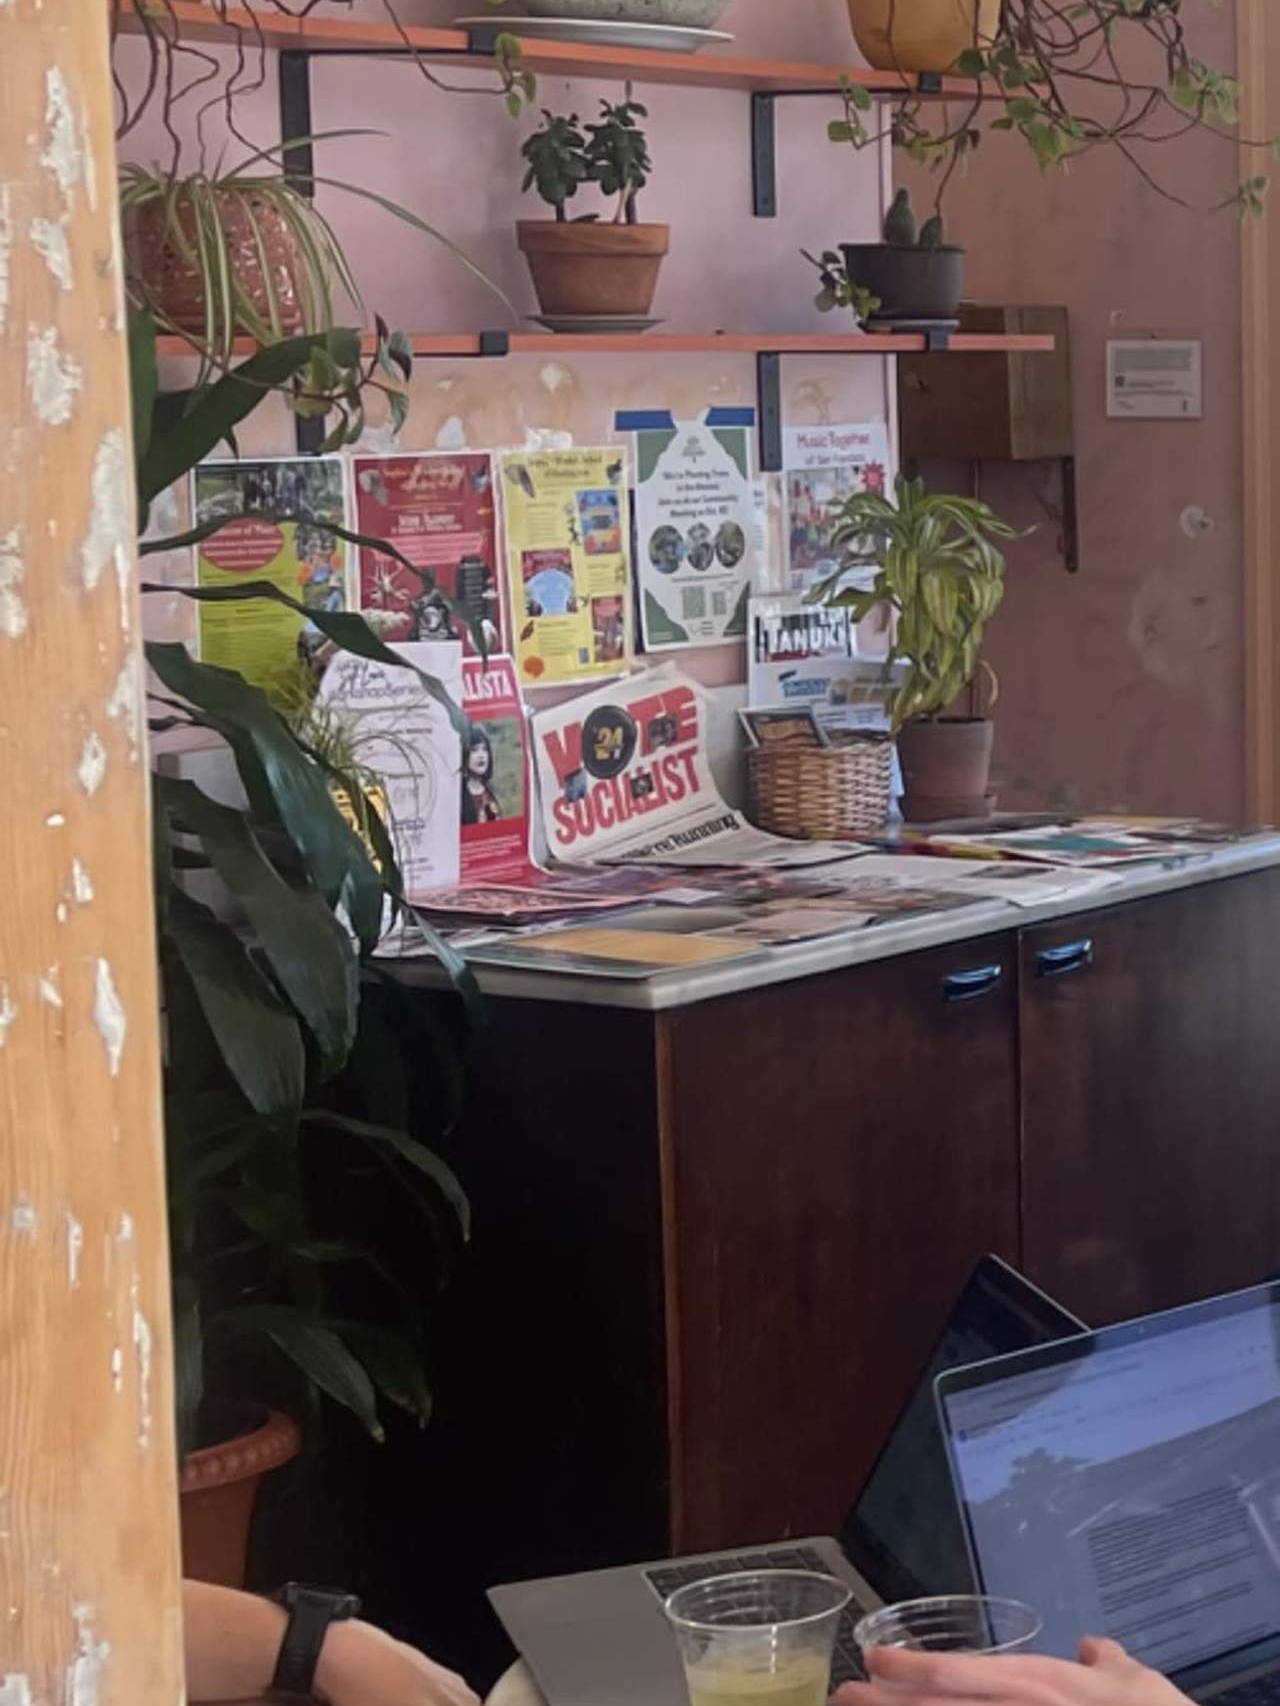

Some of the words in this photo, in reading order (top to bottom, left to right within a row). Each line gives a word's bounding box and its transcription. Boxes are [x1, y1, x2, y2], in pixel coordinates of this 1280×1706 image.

[797, 433, 828, 448] Music
[829, 431, 870, 450] Together
[552, 745, 701, 845] SOCIALIST
